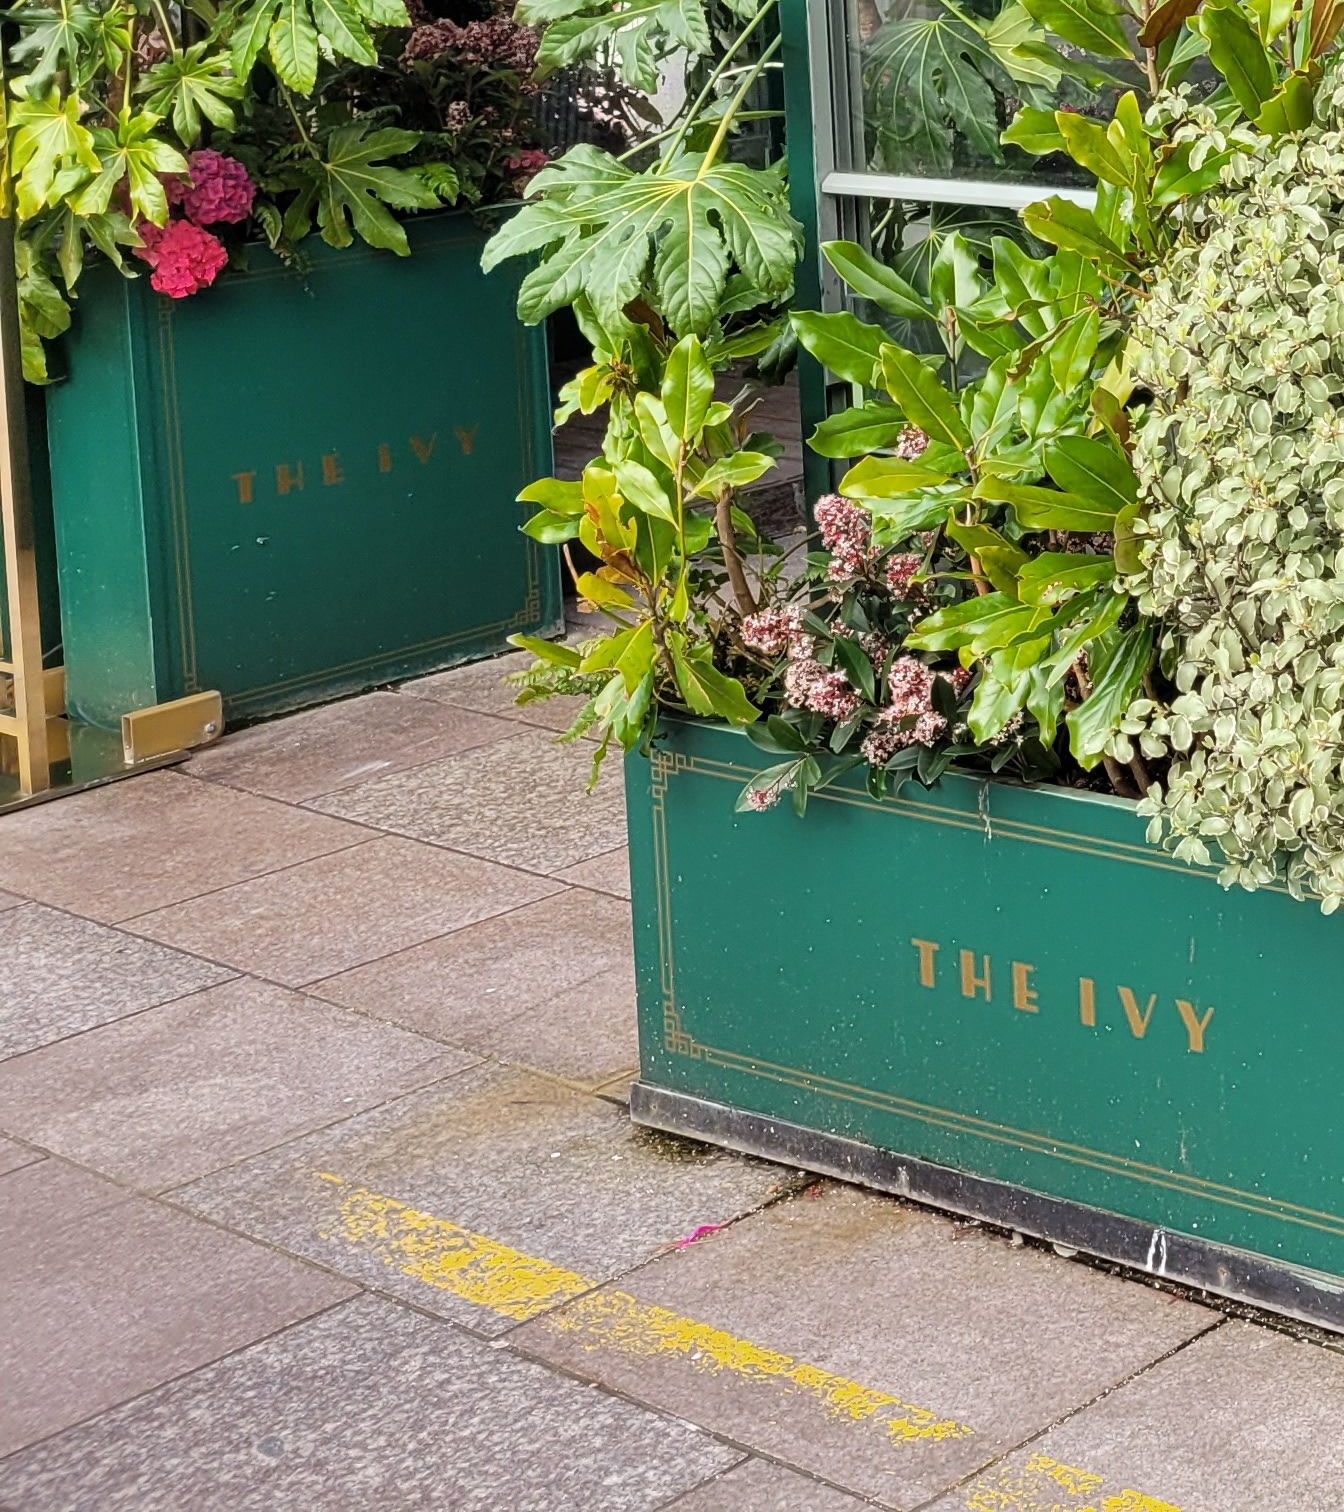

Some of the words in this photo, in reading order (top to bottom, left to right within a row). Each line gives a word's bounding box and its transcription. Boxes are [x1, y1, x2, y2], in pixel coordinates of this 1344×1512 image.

[231, 454, 345, 504] THE
[378, 422, 480, 473] IVY
[911, 938, 1040, 1014] THE
[1079, 977, 1215, 1054] IVY
